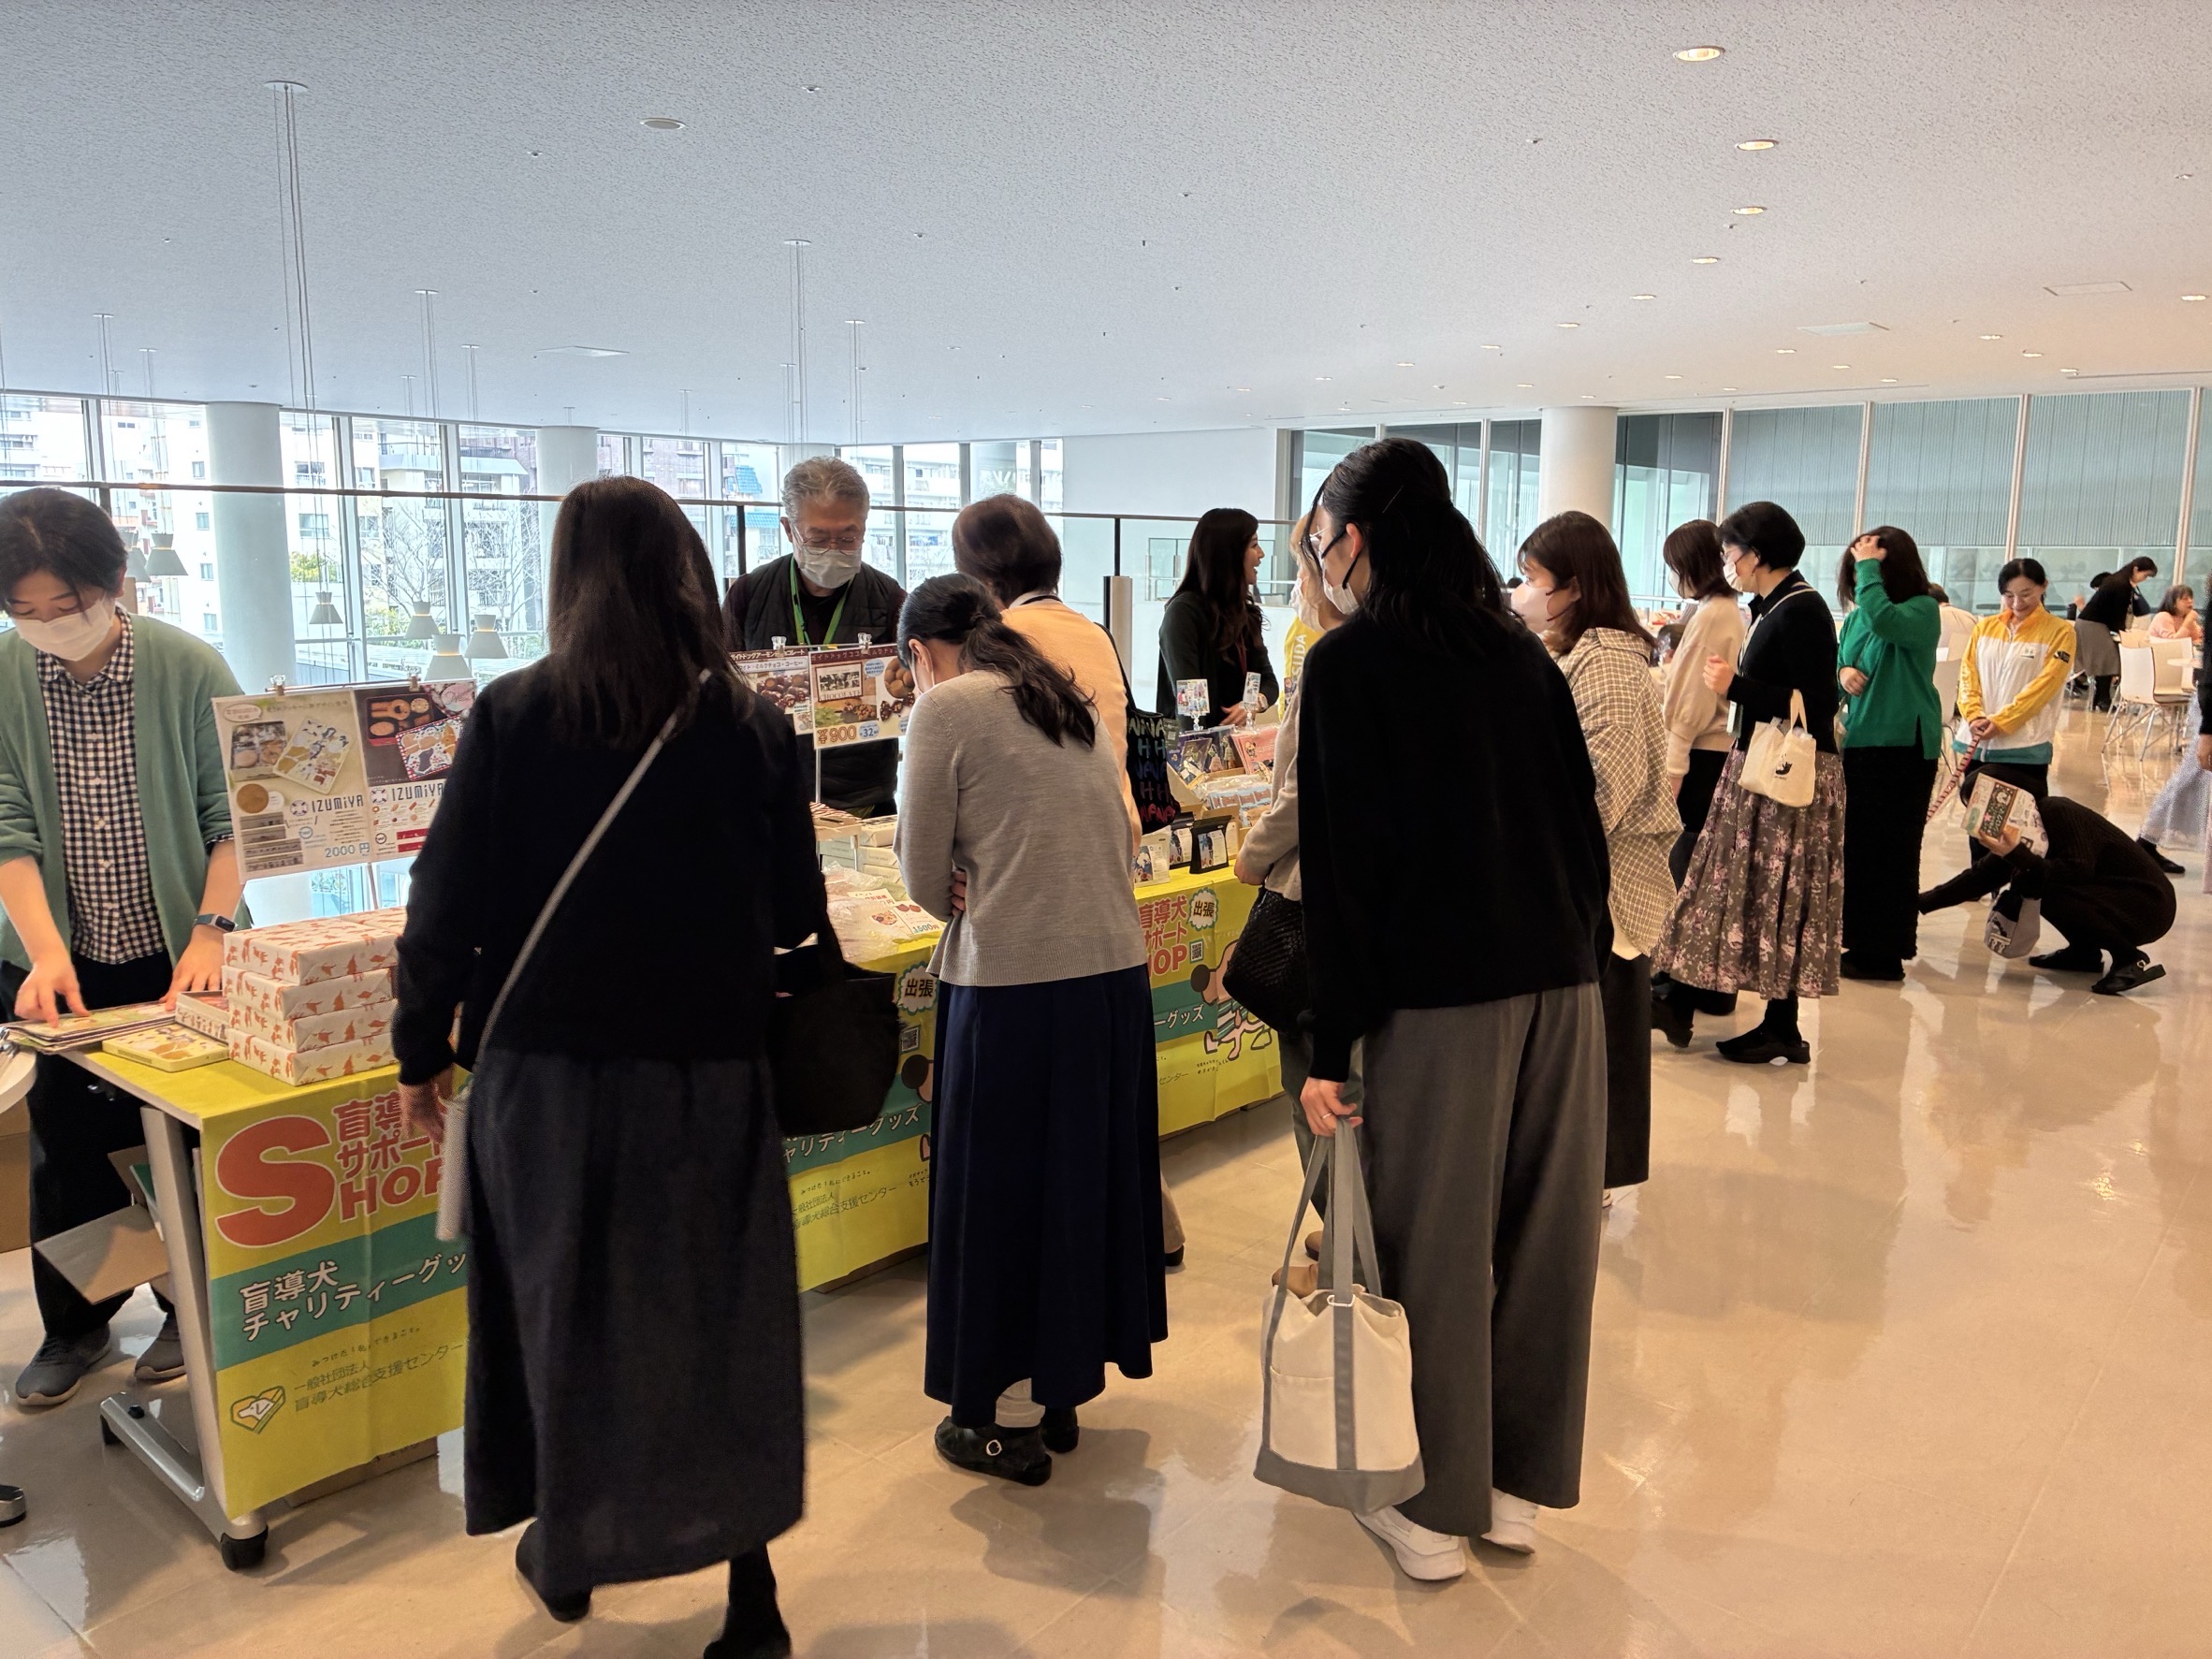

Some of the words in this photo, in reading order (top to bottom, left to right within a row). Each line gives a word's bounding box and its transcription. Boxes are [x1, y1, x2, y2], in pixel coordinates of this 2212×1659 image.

[1138, 895, 1187, 928] 盲導犬
[1193, 900, 1215, 918] 出張
[904, 978, 934, 998] 出張
[240, 1259, 340, 1315] 盲導犬
